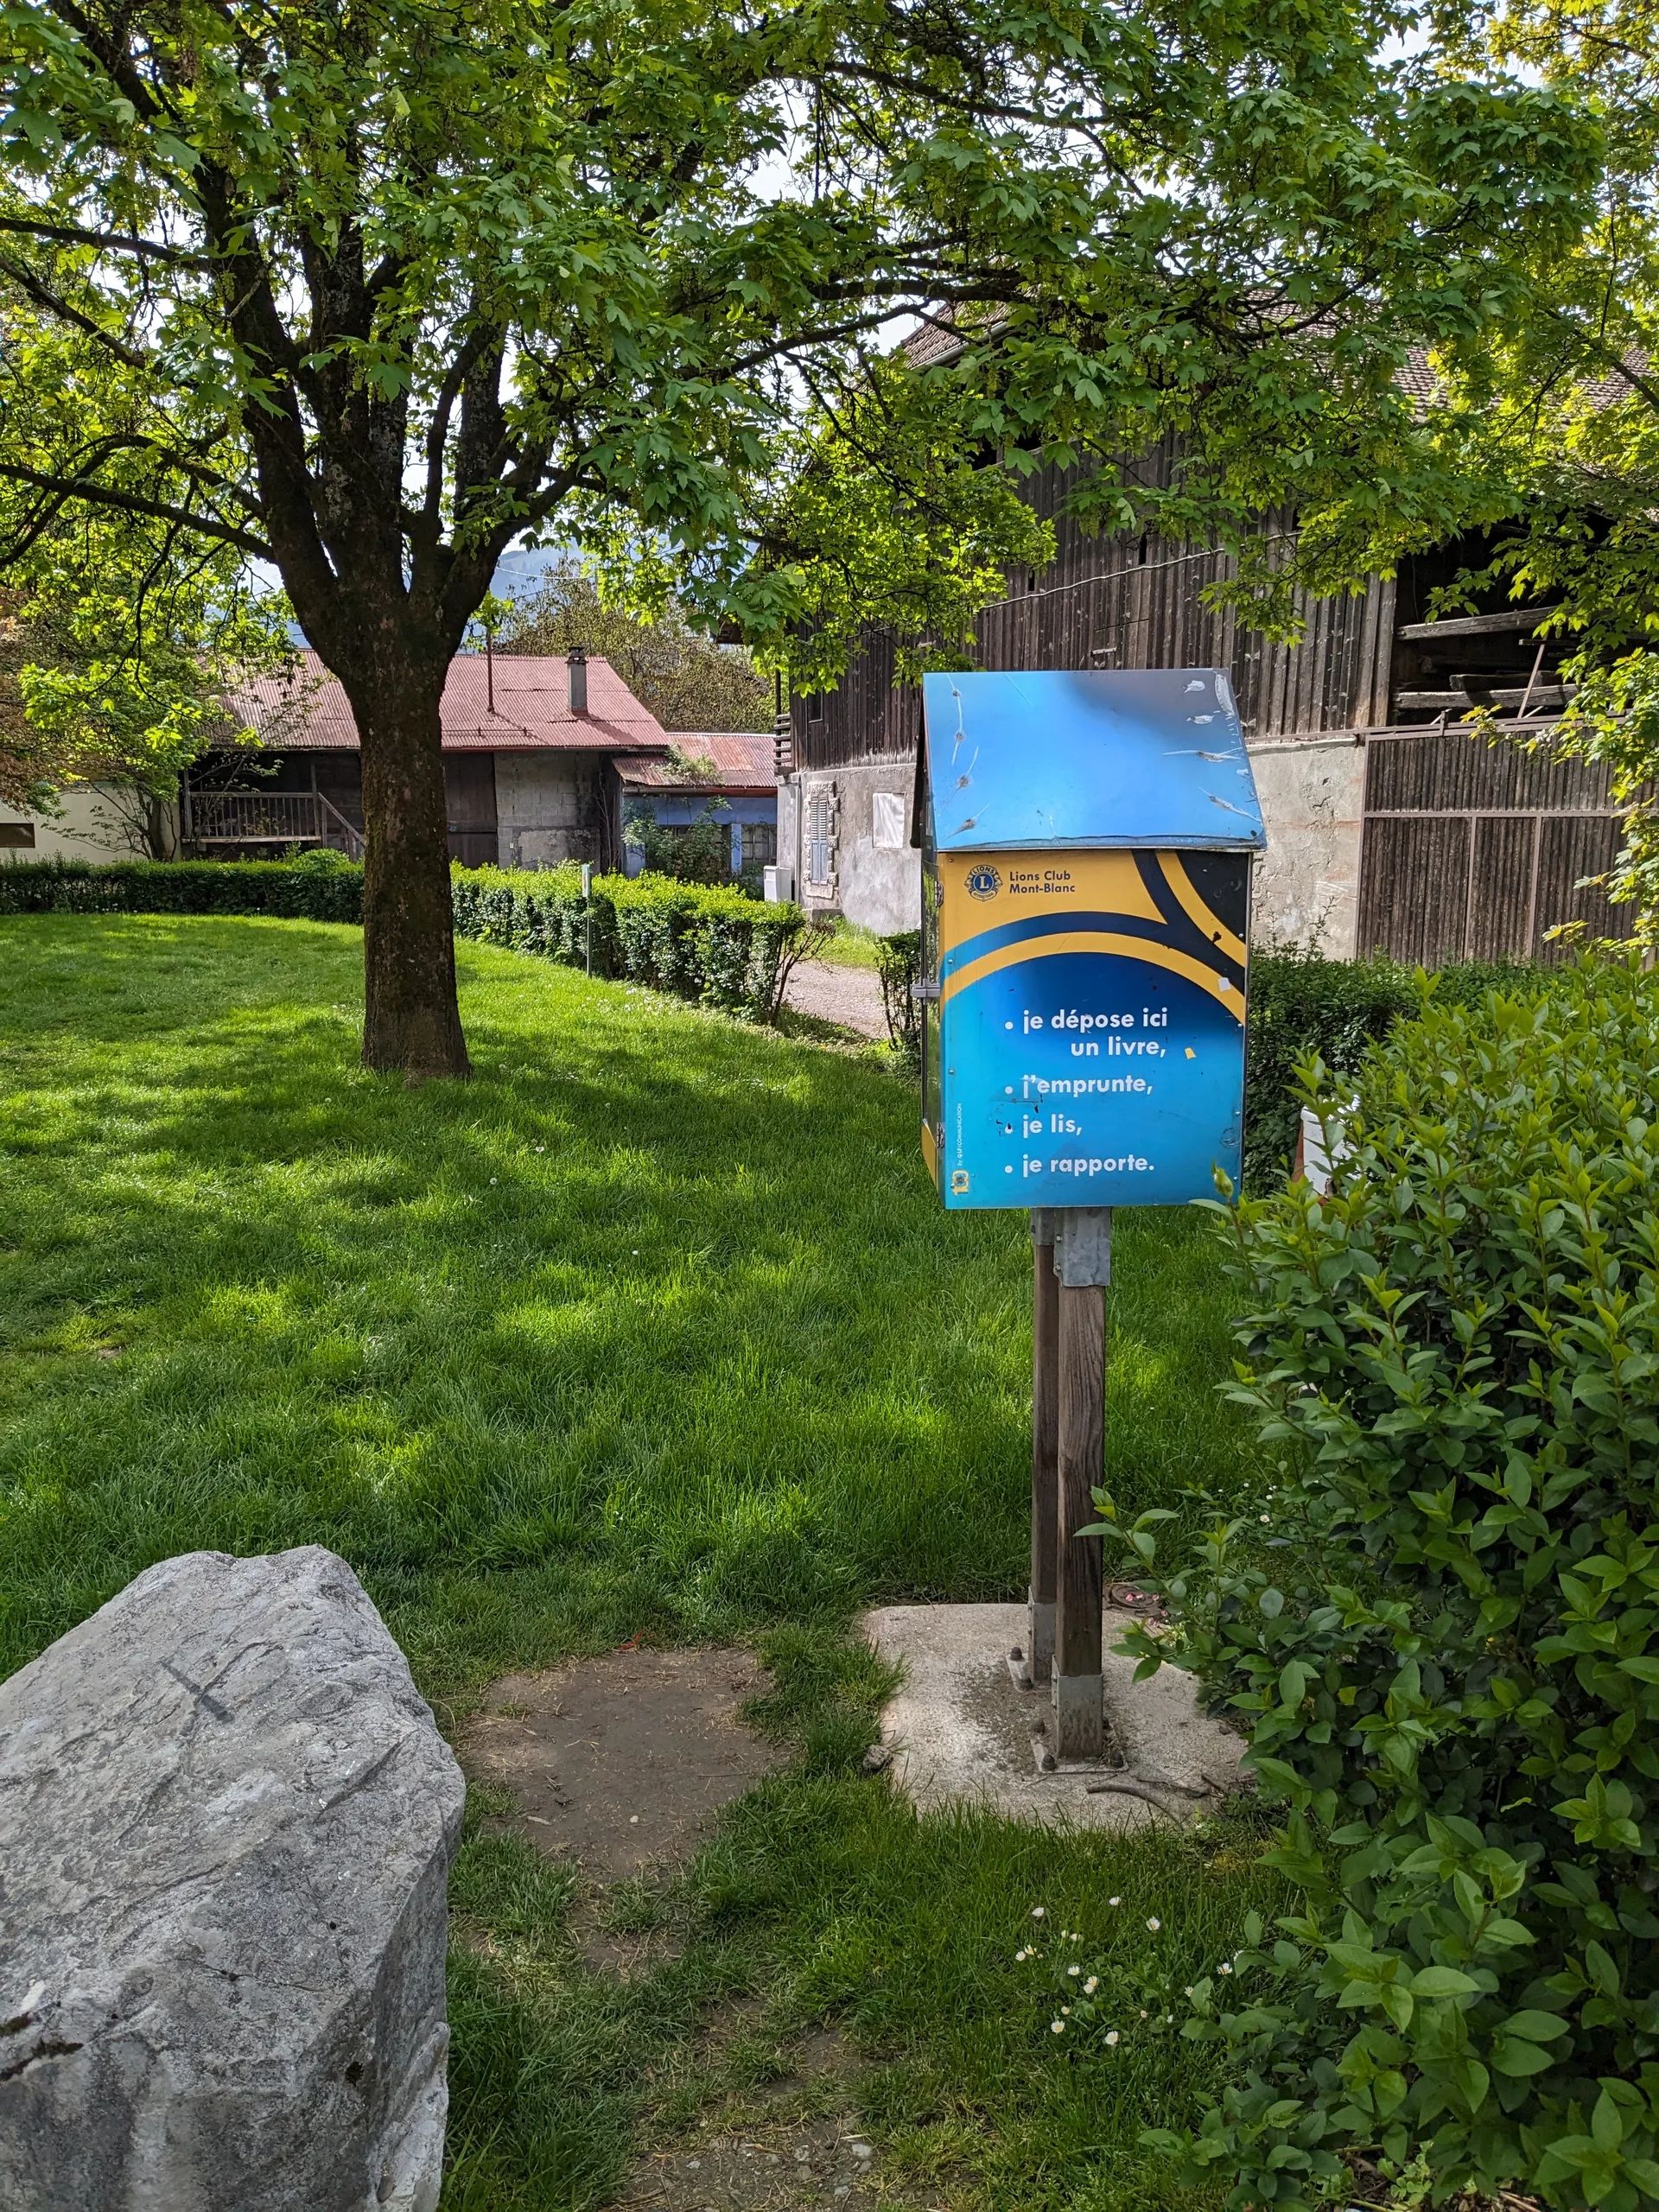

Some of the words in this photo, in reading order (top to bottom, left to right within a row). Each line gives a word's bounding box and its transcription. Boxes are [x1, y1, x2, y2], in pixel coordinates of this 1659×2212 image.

[973, 866, 995, 874] LIONS
[1009, 871, 1039, 881] Lions
[1044, 870, 1071, 880] Club
[979, 875, 989, 889] L
[1009, 883, 1076, 893] Mont-Blanc
[1023, 1009, 1044, 1035] je
[1051, 1008, 1135, 1033] dépose
[1142, 1007, 1168, 1027] ici
[1071, 1042, 1099, 1057] un
[1108, 1036, 1166, 1058] livre,
[1022, 1114, 1043, 1139] je
[1051, 1113, 1083, 1136] lis,
[1022, 1154, 1043, 1178] je
[1050, 1154, 1155, 1177] rapporte.
